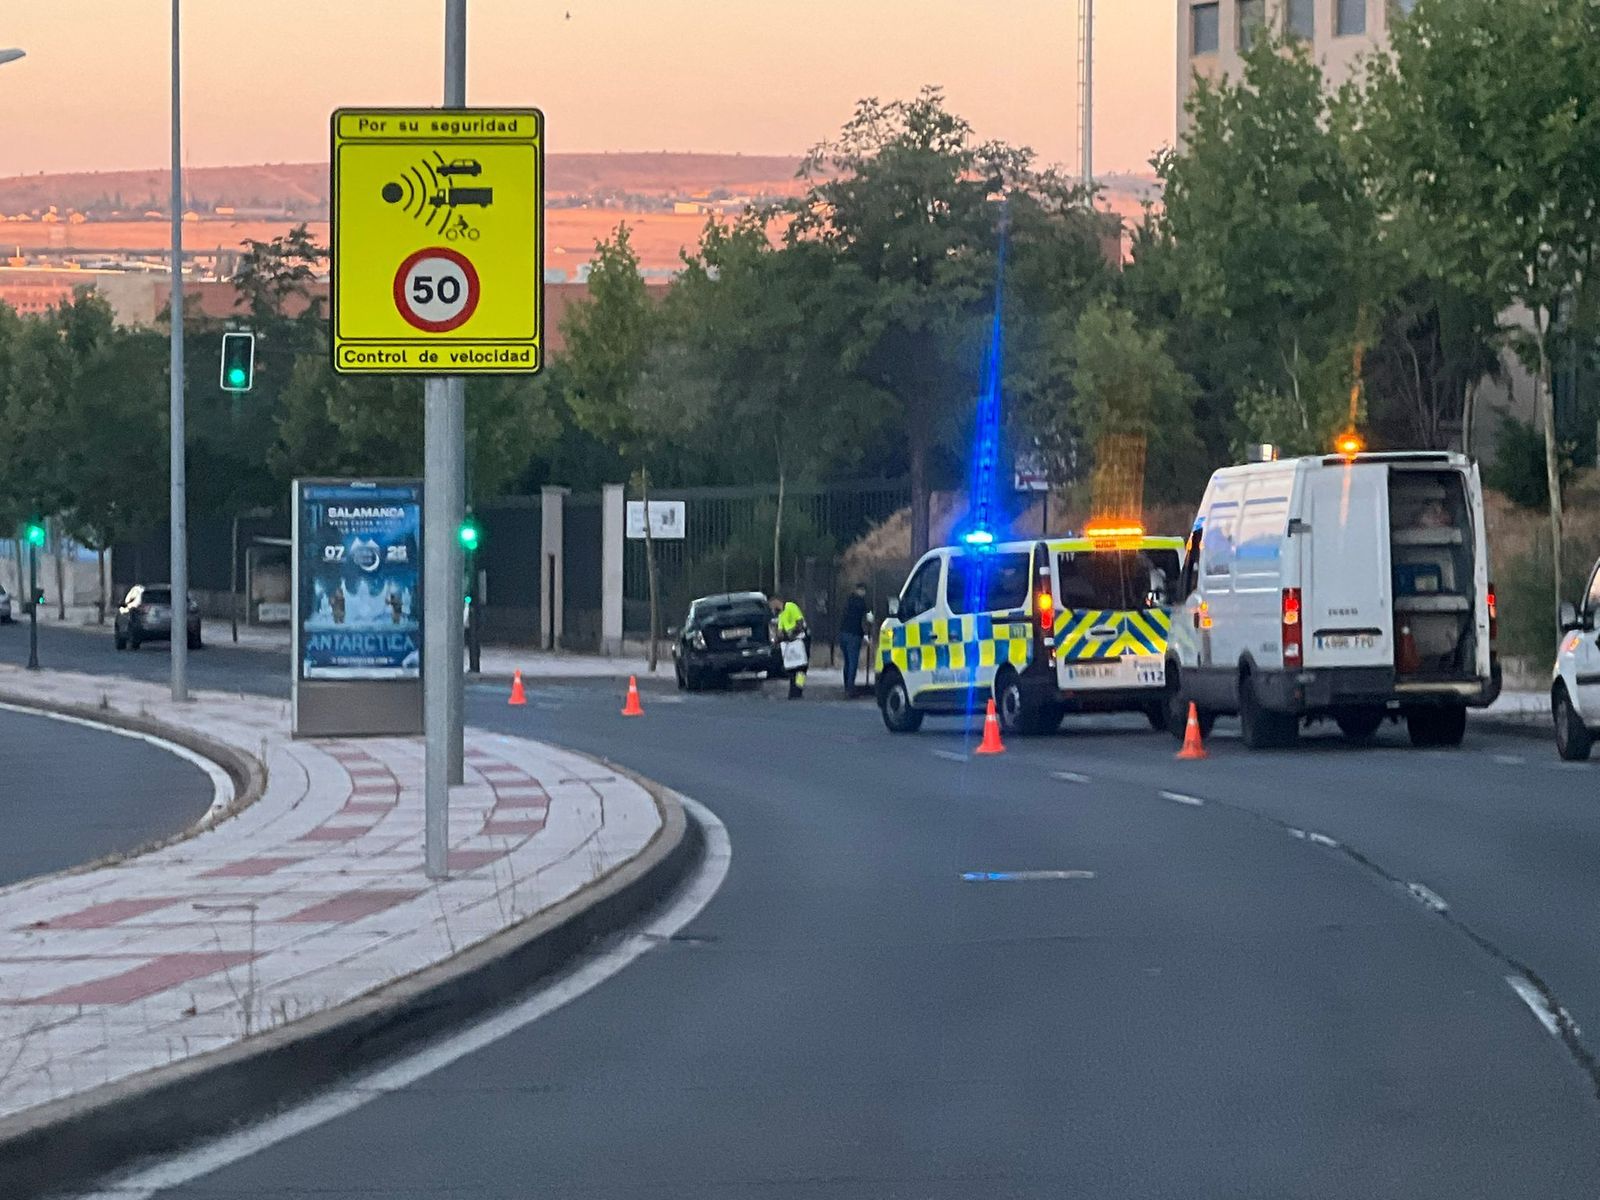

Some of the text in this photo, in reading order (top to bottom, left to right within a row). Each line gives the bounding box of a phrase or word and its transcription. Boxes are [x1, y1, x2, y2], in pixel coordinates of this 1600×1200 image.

[358, 119, 518, 134] Por su seguridad
[412, 275, 461, 305] 50
[344, 348, 531, 364] Control de velocidad
[327, 507, 405, 518] SALAMANCA
[324, 545, 345, 560] 07
[307, 633, 415, 651] ANTARCTICA
